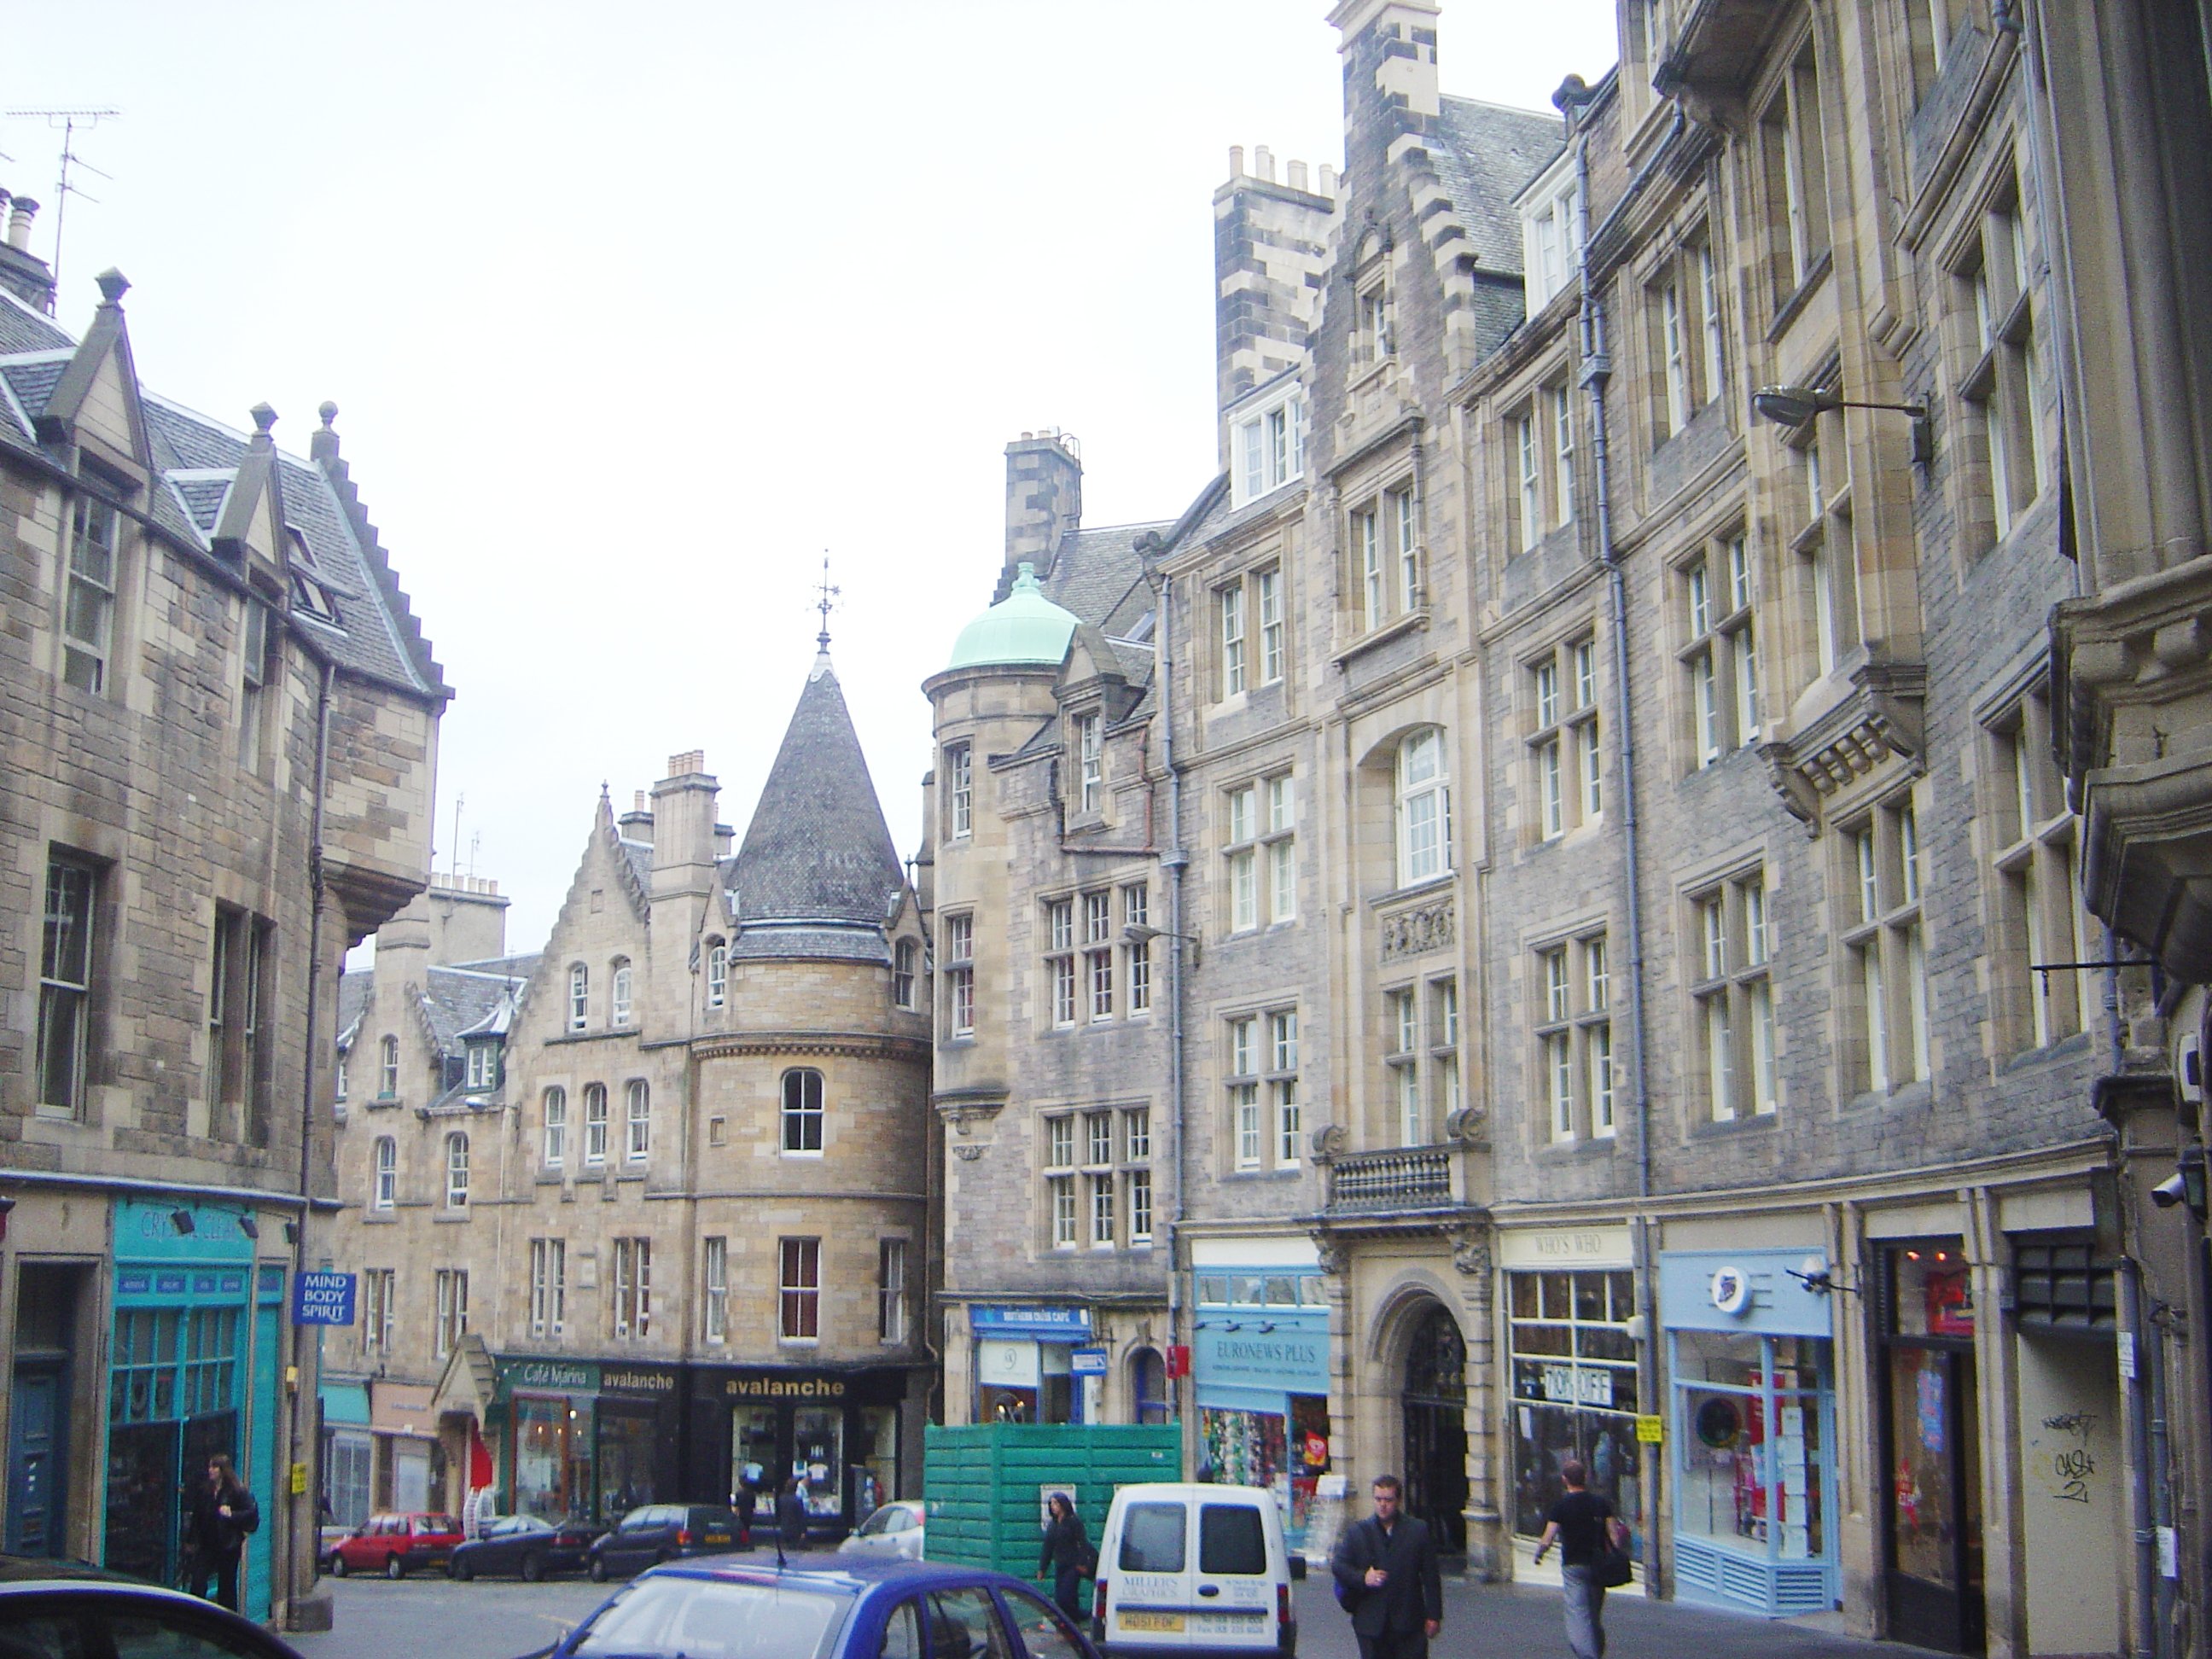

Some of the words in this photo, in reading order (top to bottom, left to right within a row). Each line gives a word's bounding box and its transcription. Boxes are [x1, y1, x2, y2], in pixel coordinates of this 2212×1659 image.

[142, 1211, 197, 1237] CRYL
[1575, 1234, 1602, 1254] WHO
[305, 1275, 346, 1288] MIND
[304, 1289, 346, 1302] BODY
[302, 1305, 345, 1322] SPIRIT
[1217, 1341, 1281, 1359] EURONEWS
[1285, 1344, 1316, 1363] PLUS
[524, 1364, 549, 1384] Café
[551, 1365, 586, 1385] Marina
[603, 1371, 674, 1390] avalanche
[726, 1377, 845, 1396] avalanche
[1578, 1371, 1610, 1401] OFF
